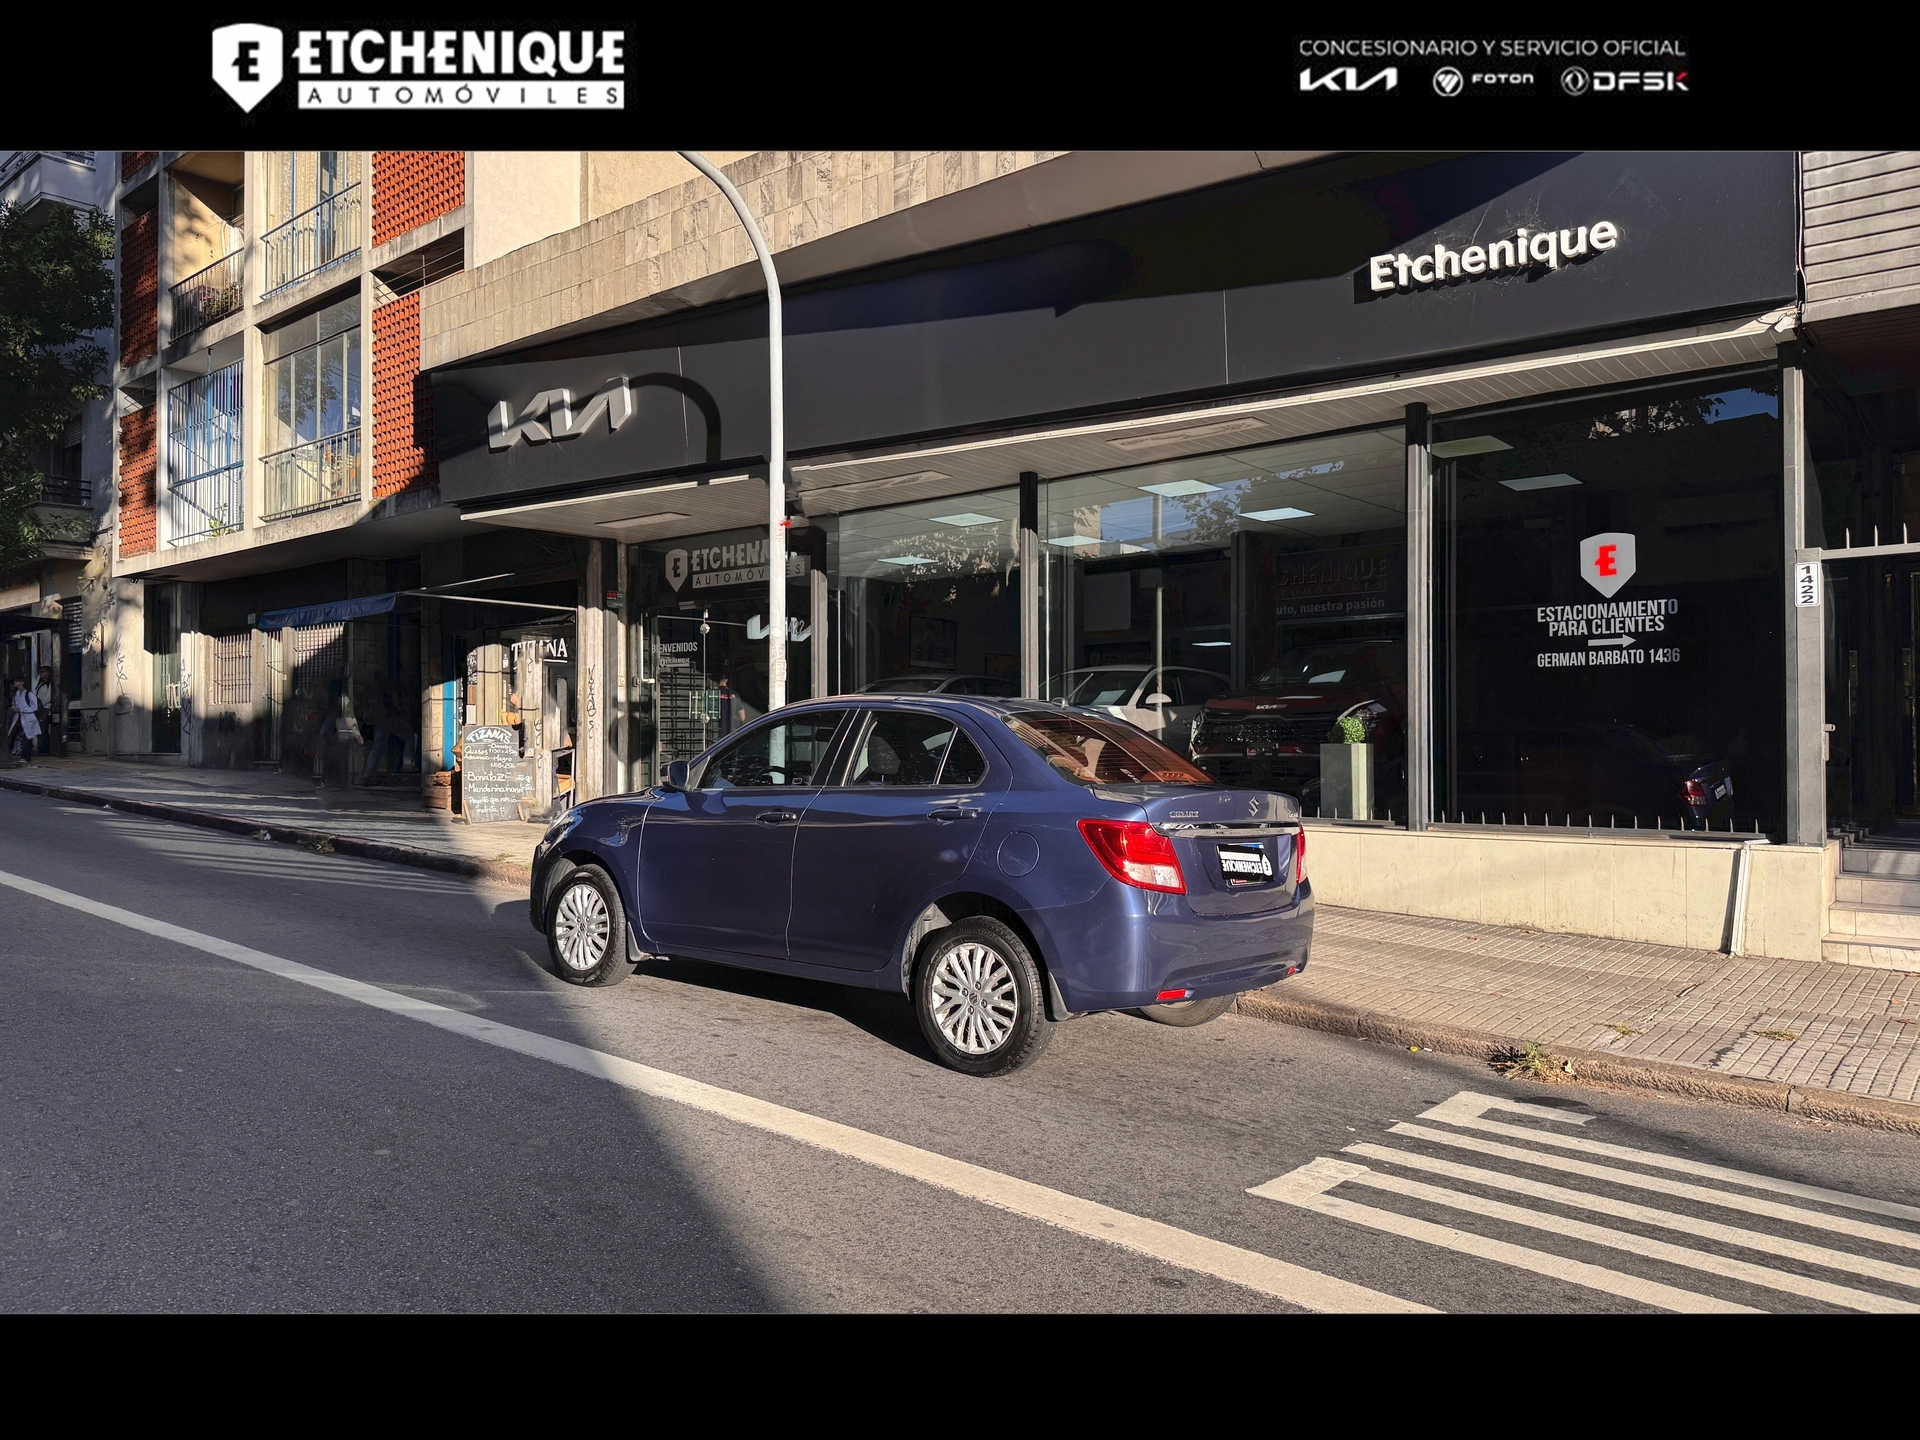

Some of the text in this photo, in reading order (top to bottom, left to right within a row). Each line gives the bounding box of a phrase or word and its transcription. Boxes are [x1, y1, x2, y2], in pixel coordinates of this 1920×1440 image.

[1370, 220, 1618, 292] Etchenique
[487, 374, 632, 453] KIA
[691, 539, 770, 573] ETCHEN
[694, 562, 802, 587] AUTOMÓVES
[1799, 563, 1815, 606] 1422
[1276, 596, 1385, 616] uto, nuestra pasión
[1537, 598, 1679, 623] ESTACIONAMIENTO
[1548, 615, 1665, 637] PARA CLIENTES
[651, 641, 698, 654] BIENVENIDOS
[1536, 647, 1681, 668] GERMAN BARBATO 1436
